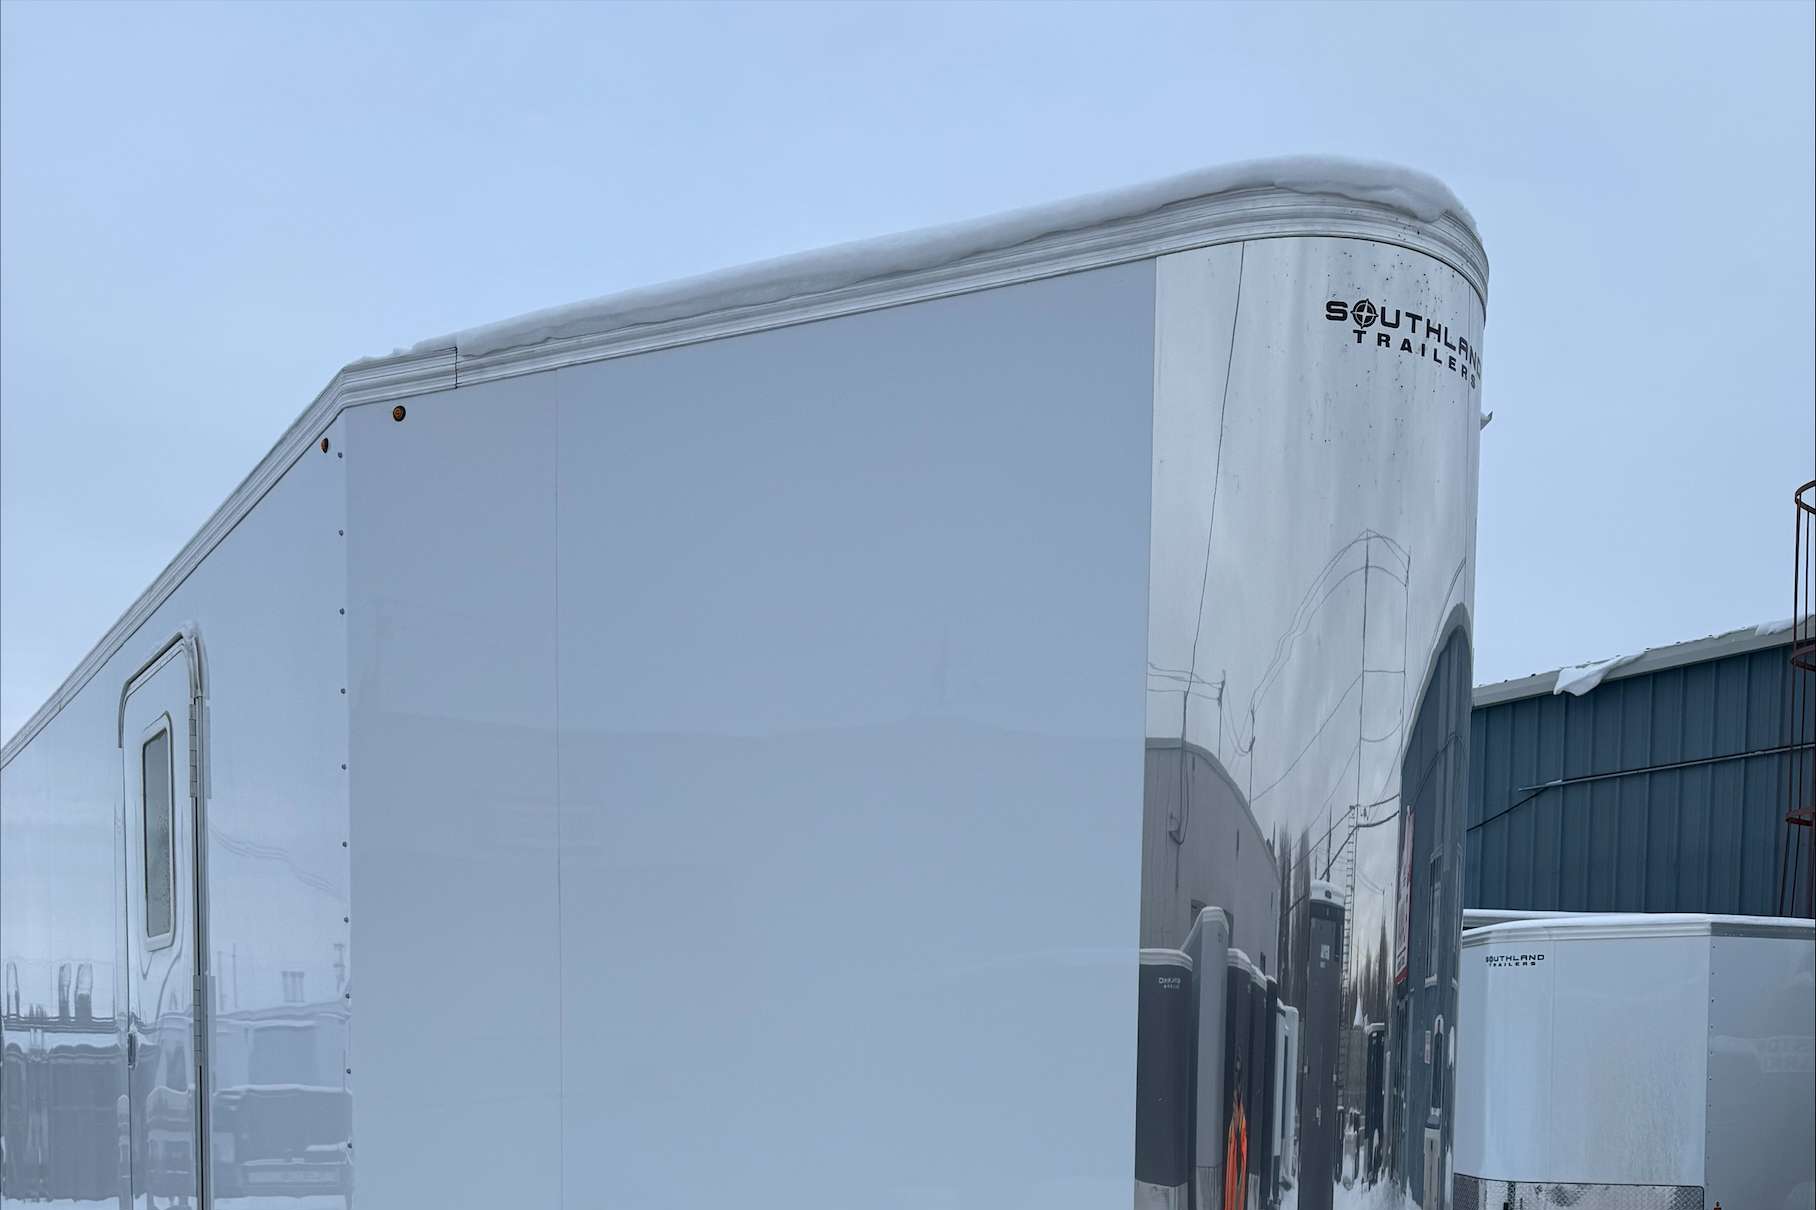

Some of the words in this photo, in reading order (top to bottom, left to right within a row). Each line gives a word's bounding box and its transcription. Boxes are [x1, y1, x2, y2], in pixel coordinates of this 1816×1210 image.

[1325, 298, 1482, 381] SOUTHLAND
[1352, 329, 1477, 390] TRAILERS
[1485, 954, 1545, 962] SOUTHLAND
